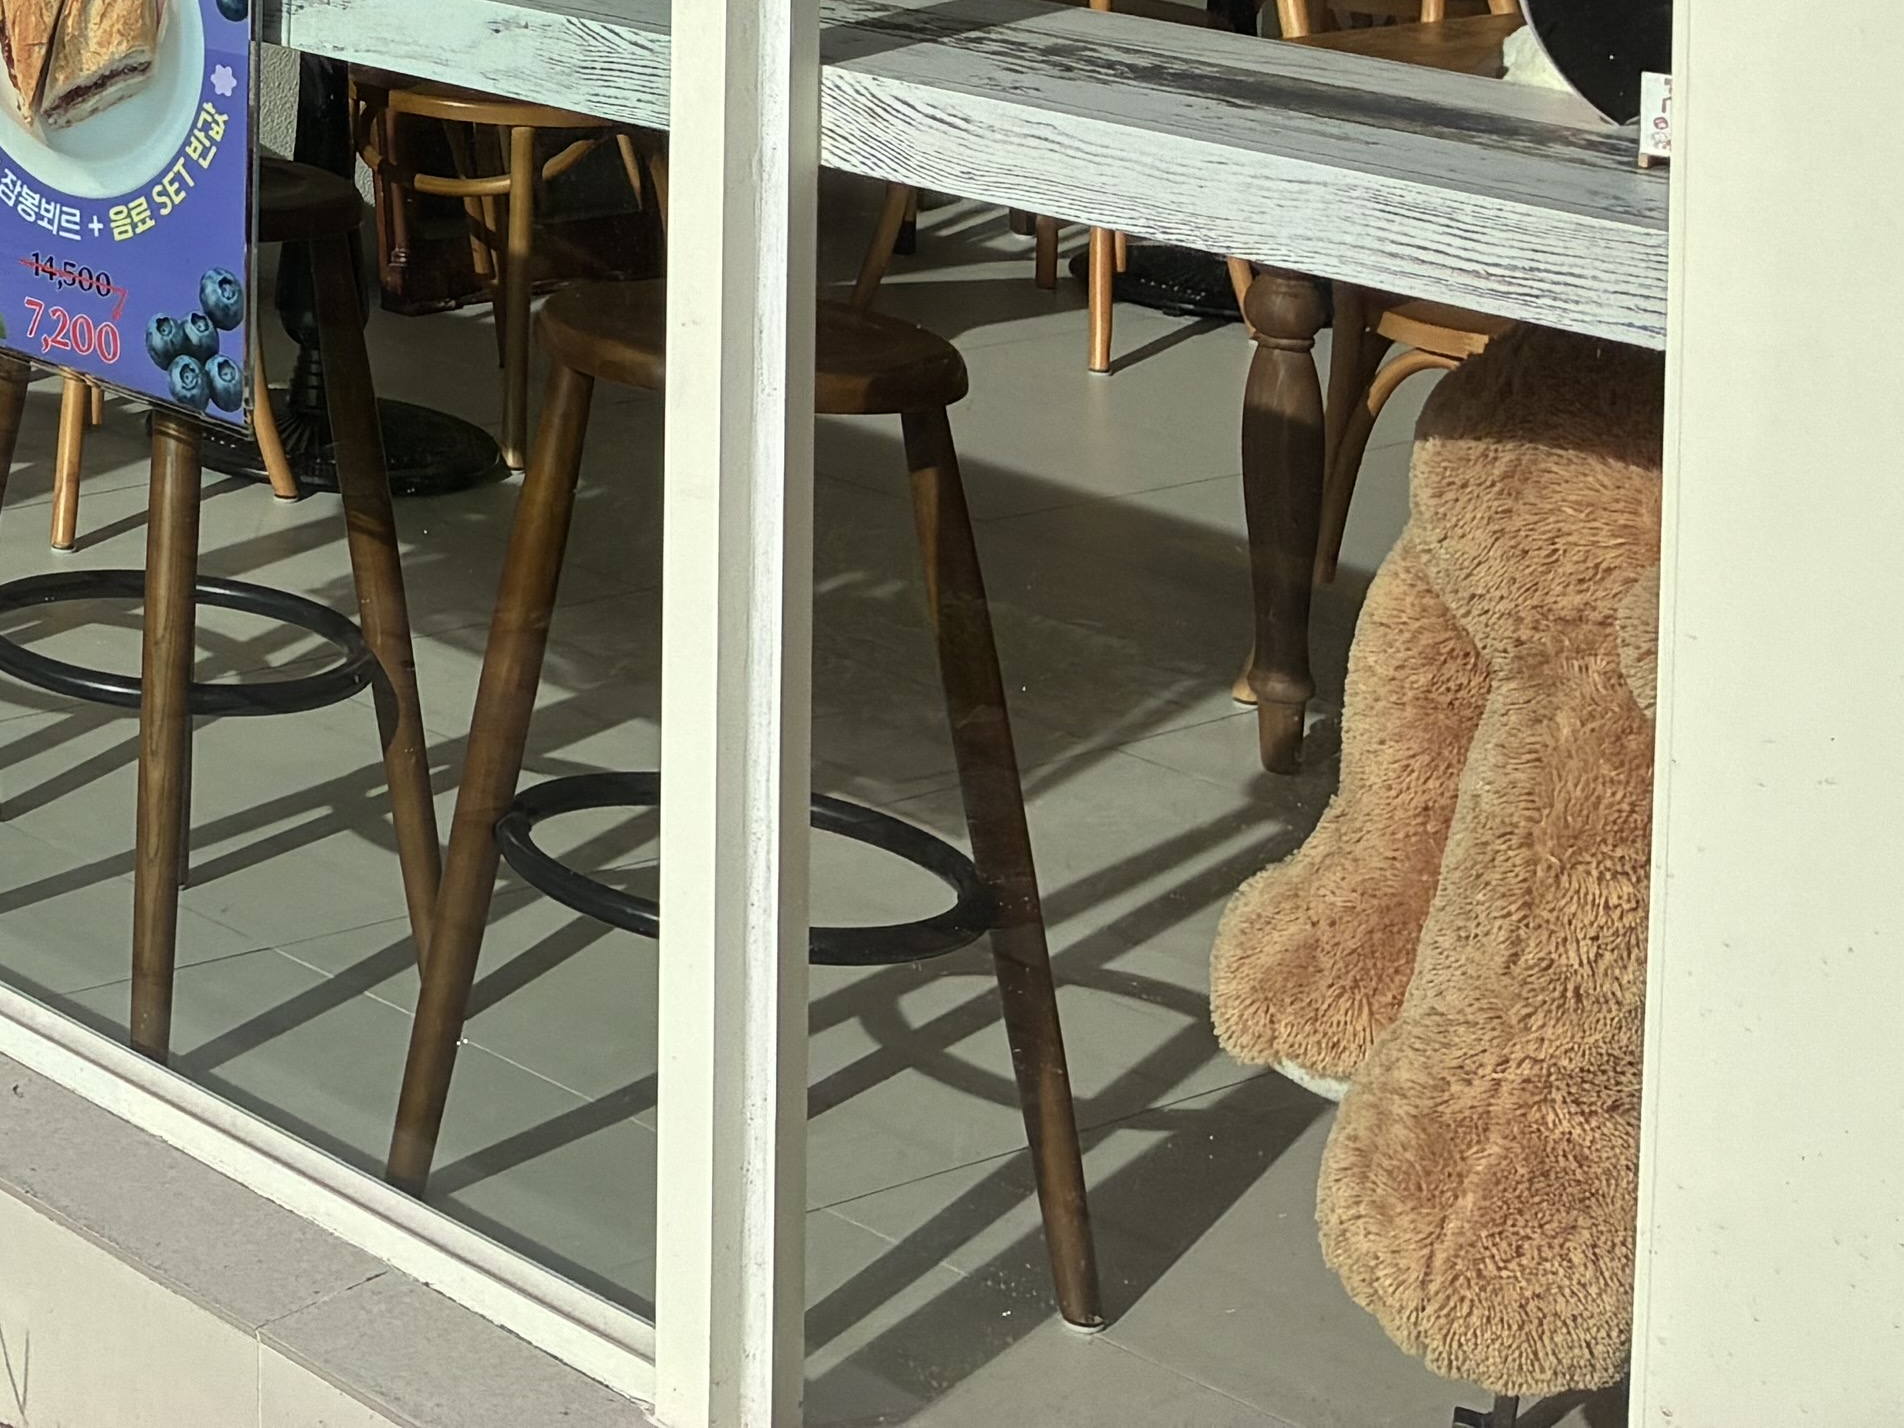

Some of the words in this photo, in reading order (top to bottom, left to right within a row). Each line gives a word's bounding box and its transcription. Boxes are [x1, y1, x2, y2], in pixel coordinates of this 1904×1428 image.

[108, 194, 157, 243] 음료
[150, 156, 196, 216] SET
[185, 100, 230, 171] 반값
[30, 250, 113, 299] 14,500
[22, 295, 122, 366] 7,200
